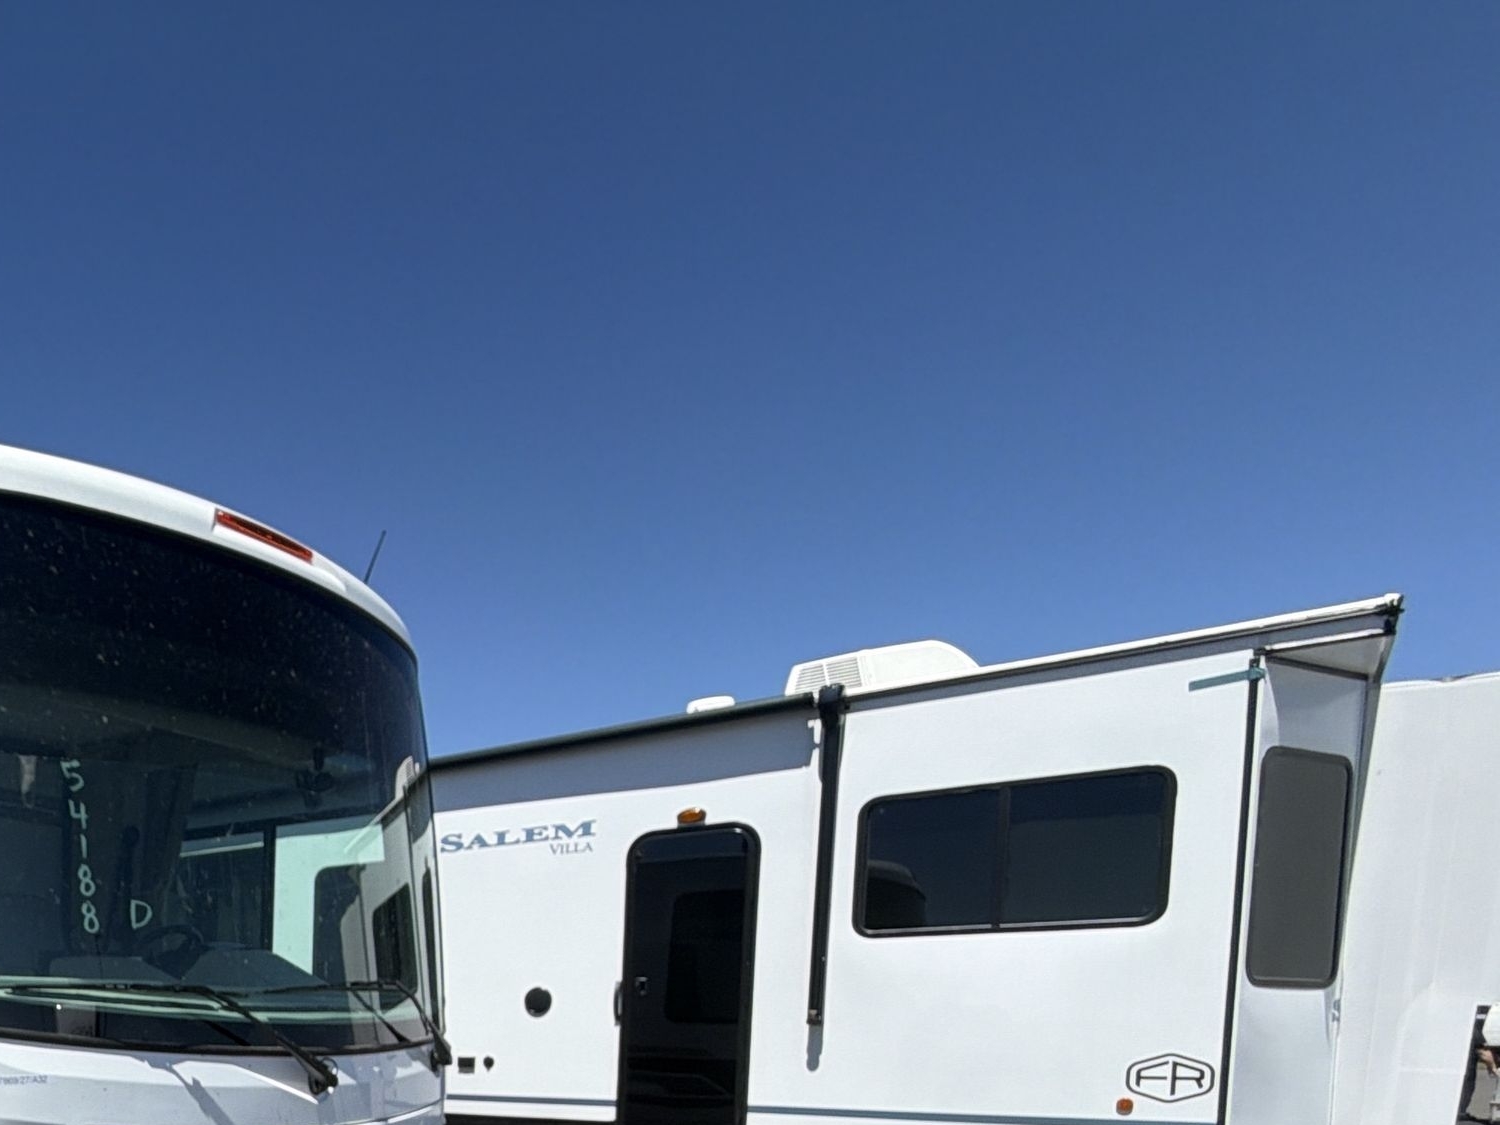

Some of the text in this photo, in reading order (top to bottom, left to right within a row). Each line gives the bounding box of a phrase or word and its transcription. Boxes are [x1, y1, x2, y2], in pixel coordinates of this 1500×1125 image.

[60, 759, 100, 933] 54188
[440, 819, 597, 853] SALEM
[550, 843, 593, 855] VILLA
[130, 899, 152, 929] D
[1135, 1060, 1205, 1096] FR
